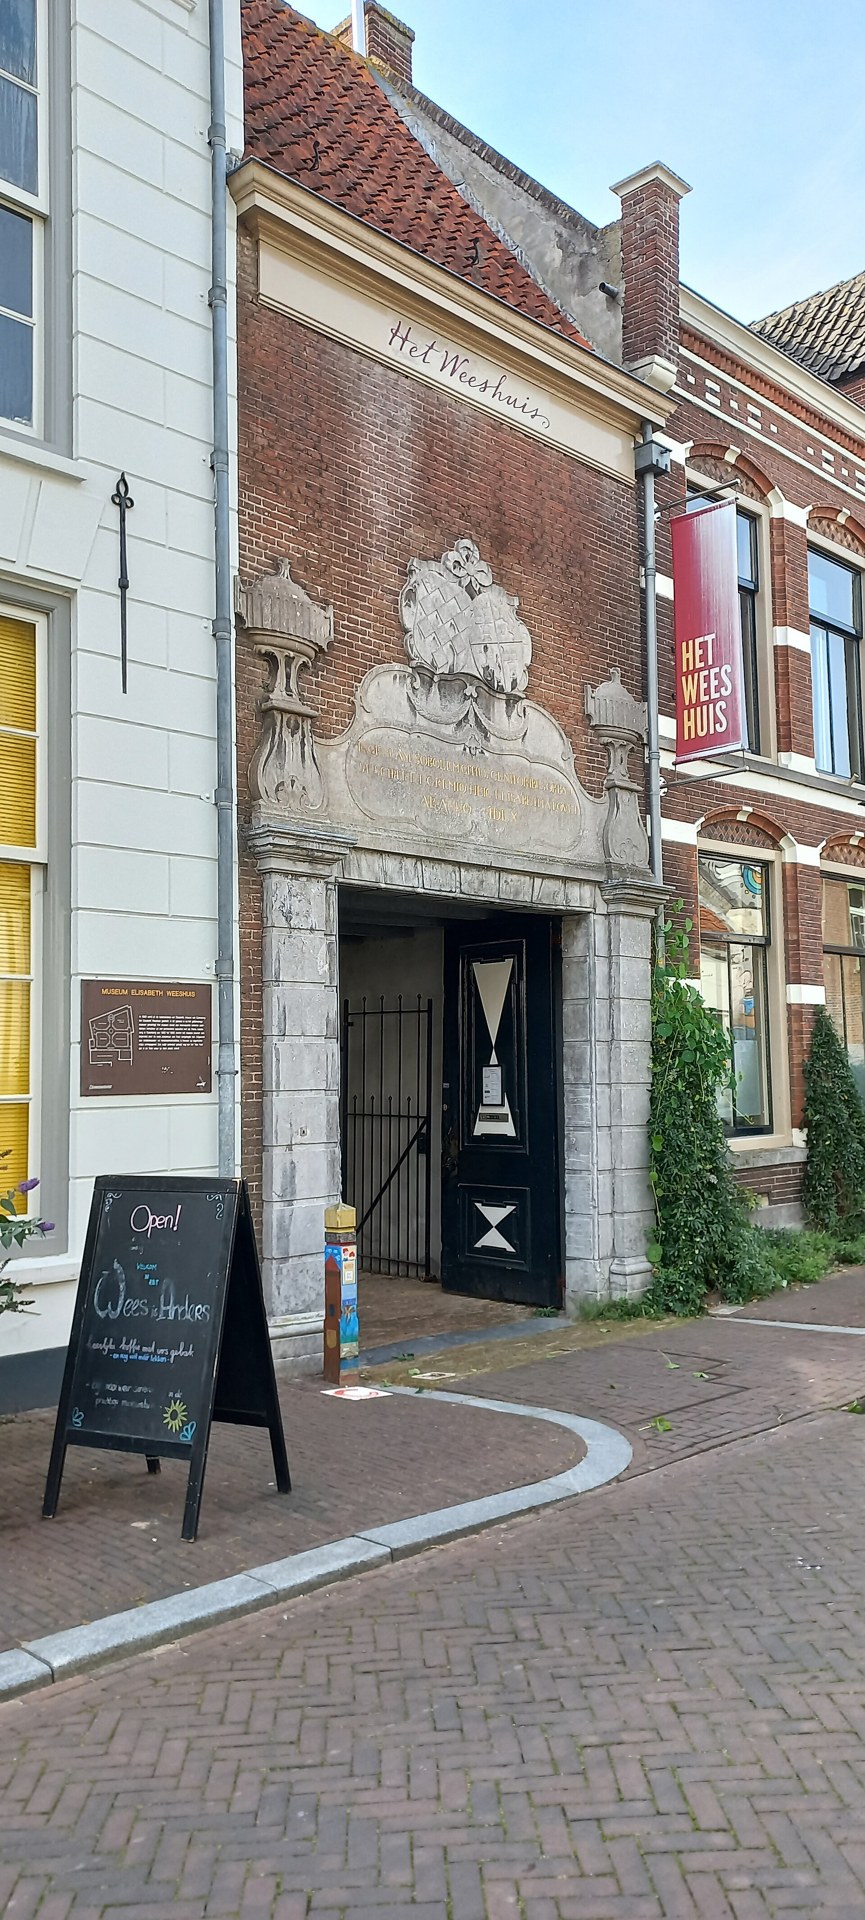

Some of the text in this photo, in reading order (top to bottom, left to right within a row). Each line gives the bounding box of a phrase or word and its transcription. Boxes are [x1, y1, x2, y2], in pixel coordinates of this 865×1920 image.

[388, 320, 550, 429] Het Weeshuis
[681, 633, 716, 673] HET
[681, 664, 732, 706] WEES
[683, 700, 728, 741] HUIS
[101, 988, 196, 998] MUSEUM ELISABETH WEESHUIS
[130, 1204, 182, 1238] Open!
